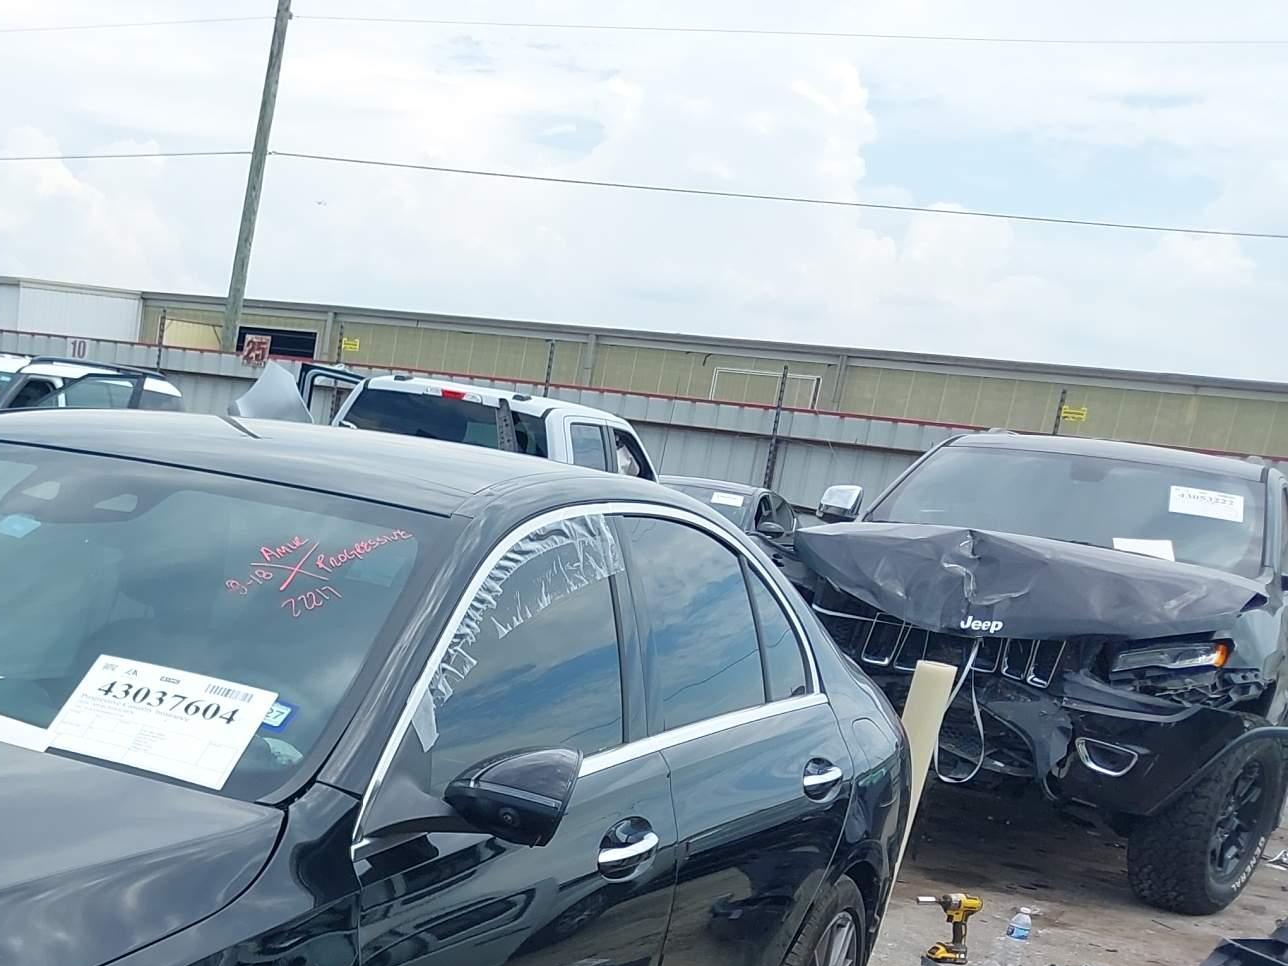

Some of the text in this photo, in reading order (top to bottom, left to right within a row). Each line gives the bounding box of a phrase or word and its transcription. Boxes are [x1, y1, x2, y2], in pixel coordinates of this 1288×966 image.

[70, 339, 87, 359] 10
[243, 340, 268, 361] 25
[960, 615, 1004, 634] Jeep
[97, 680, 240, 725] 43037604
[265, 707, 285, 719] 27
